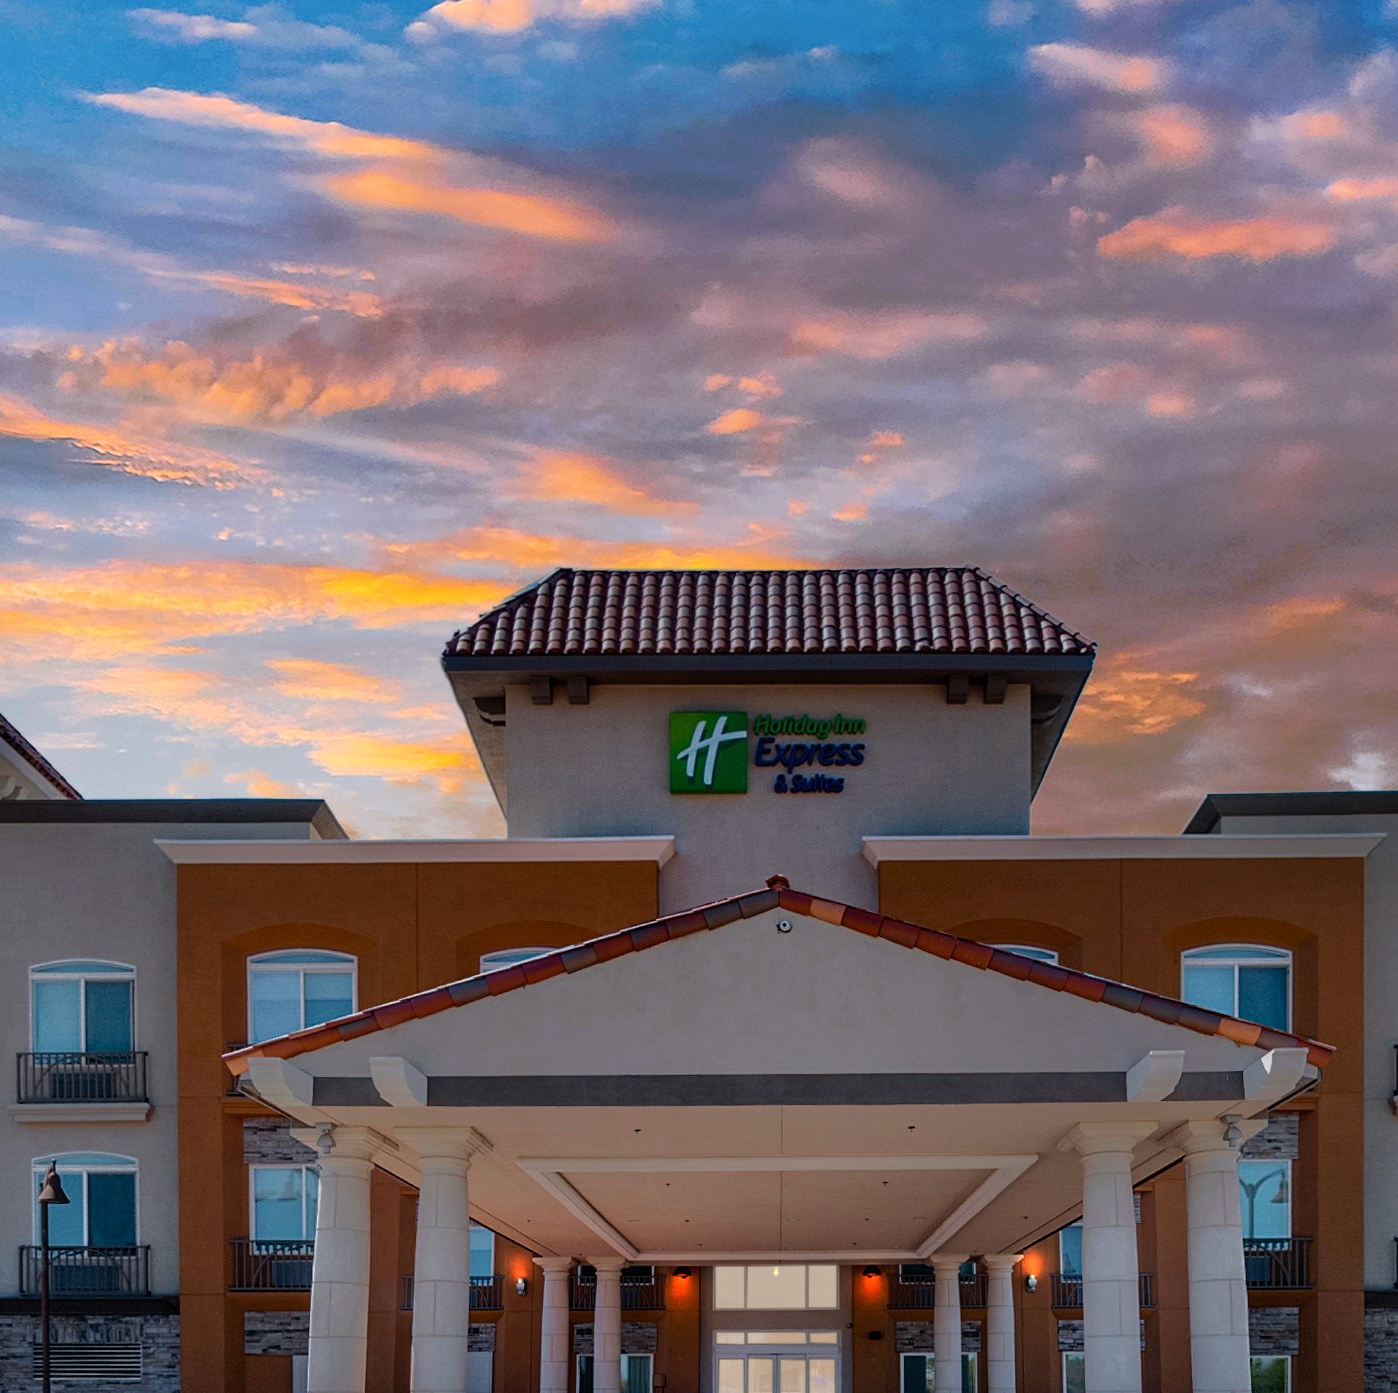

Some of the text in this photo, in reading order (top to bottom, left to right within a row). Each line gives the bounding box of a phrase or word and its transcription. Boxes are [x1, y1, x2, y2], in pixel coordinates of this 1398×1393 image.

[754, 713, 866, 740] Holiday Inn
[754, 737, 866, 774] Express
[774, 774, 845, 793] & Suites
